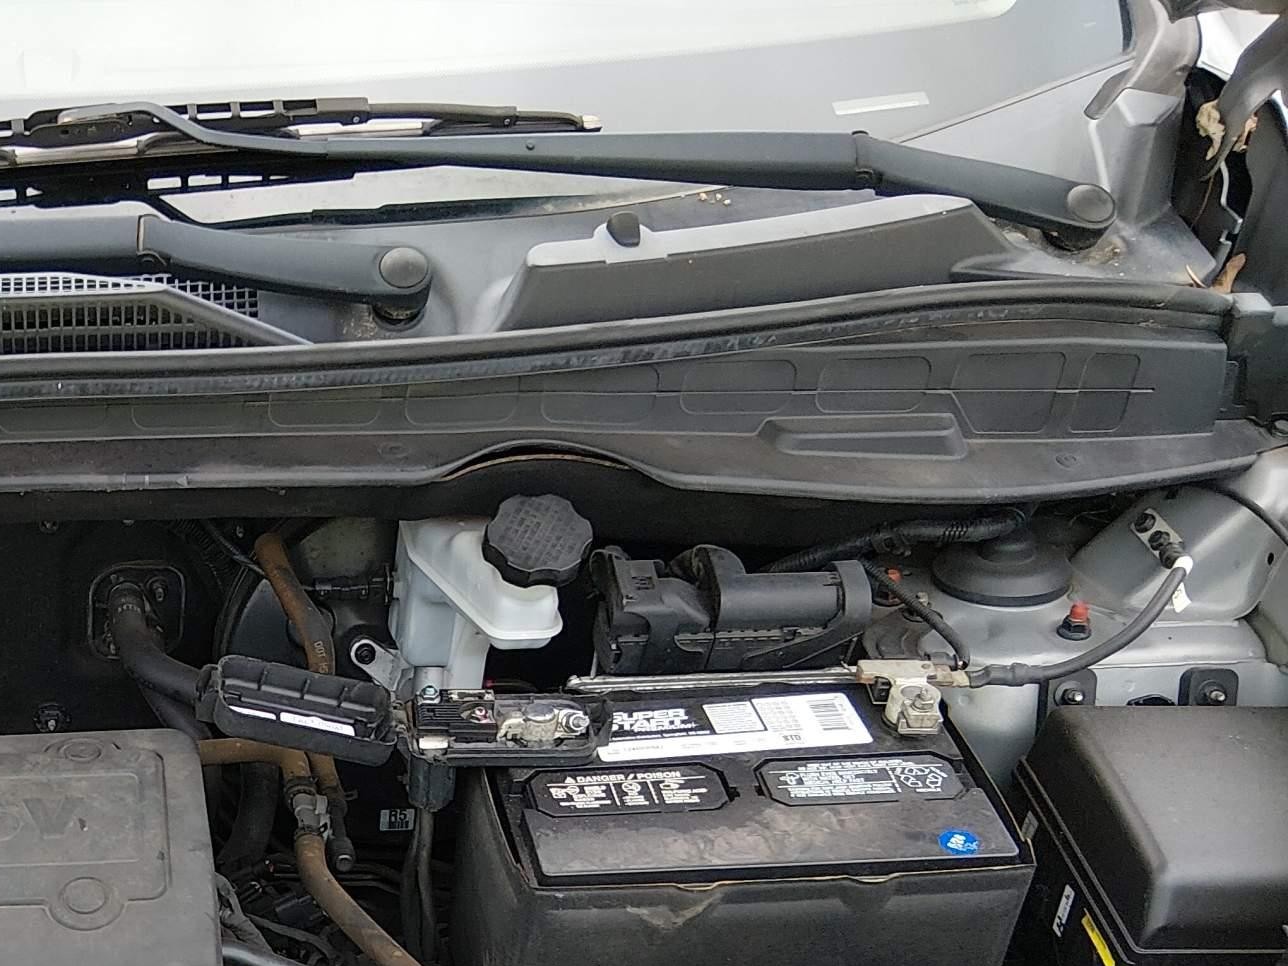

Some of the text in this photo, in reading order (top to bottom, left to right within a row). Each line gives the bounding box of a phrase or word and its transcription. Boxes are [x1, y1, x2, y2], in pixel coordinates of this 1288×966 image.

[612, 708, 689, 722] SUPER
[576, 773, 626, 783] DANGER
[636, 771, 682, 780] POISON
